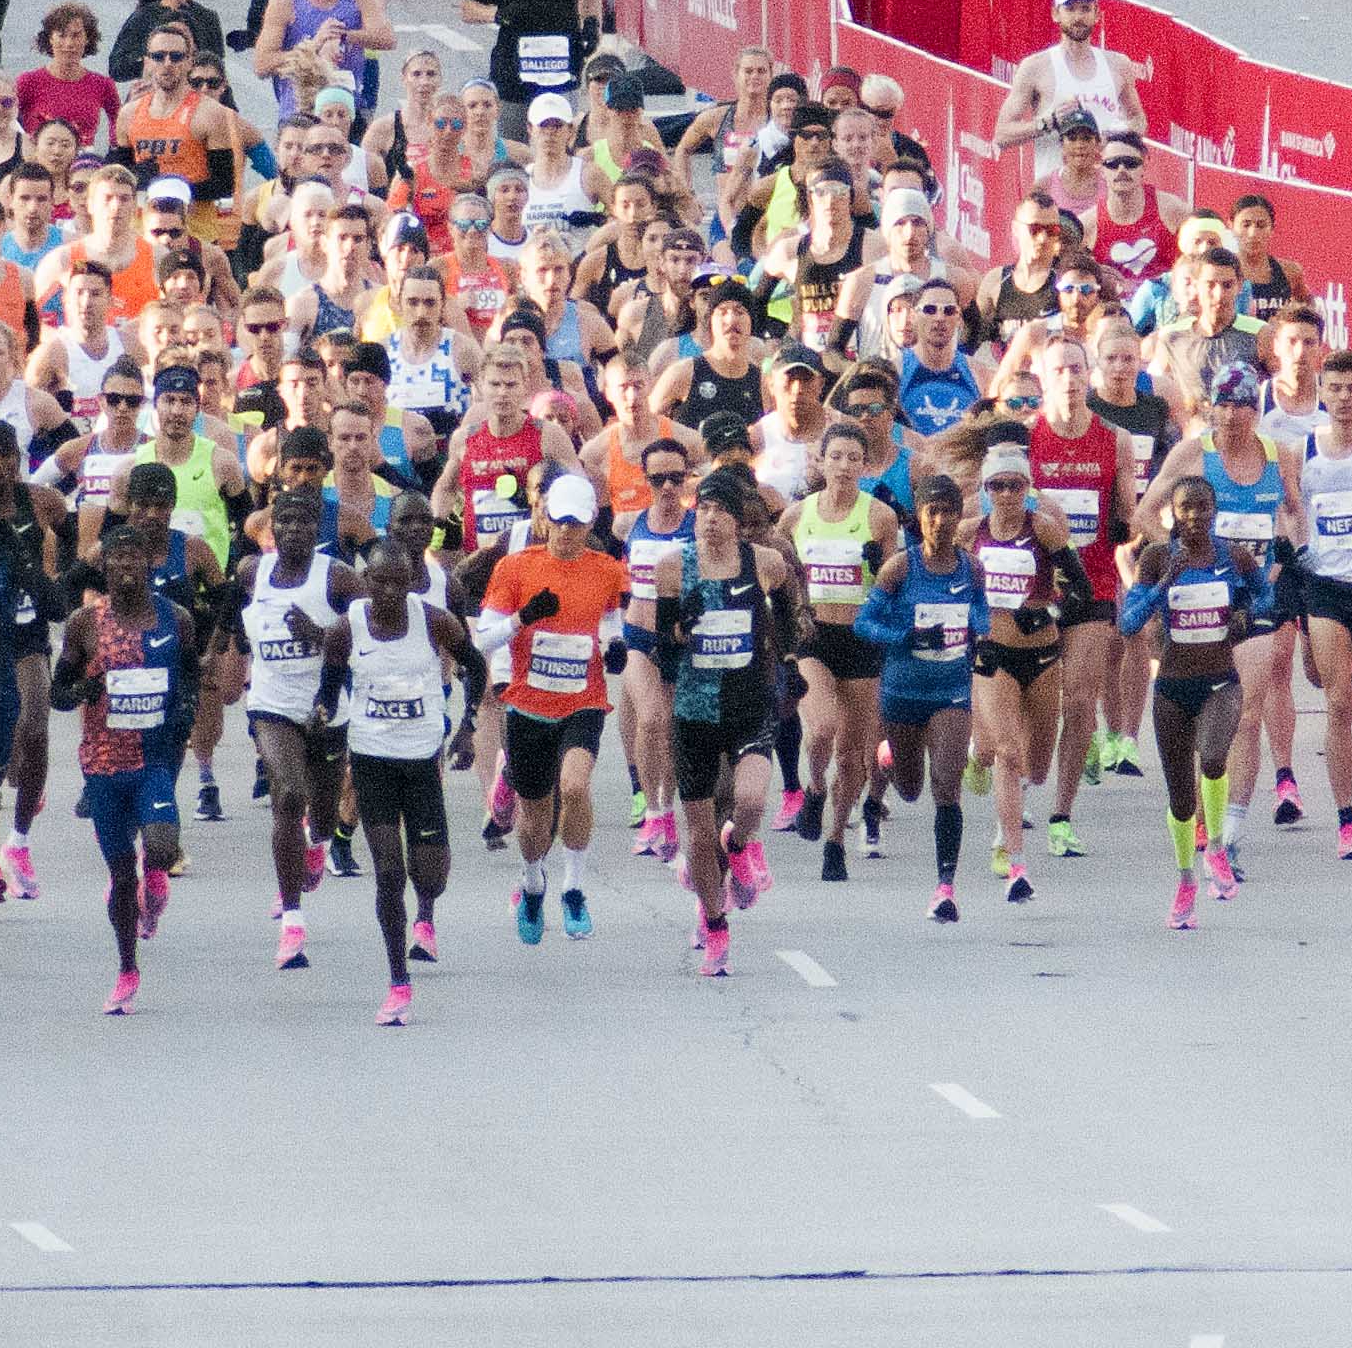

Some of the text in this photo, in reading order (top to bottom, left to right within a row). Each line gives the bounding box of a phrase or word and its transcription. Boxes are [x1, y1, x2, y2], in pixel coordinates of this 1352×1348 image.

[520, 59, 568, 72] GALLEGOS
[482, 514, 521, 531] GIVE
[810, 568, 855, 583] BATES
[1178, 610, 1221, 628] SAINA
[259, 641, 303, 660] PACE
[702, 636, 742, 652] RUPP
[531, 659, 587, 676] STINSON
[367, 702, 422, 719] PACE 1
